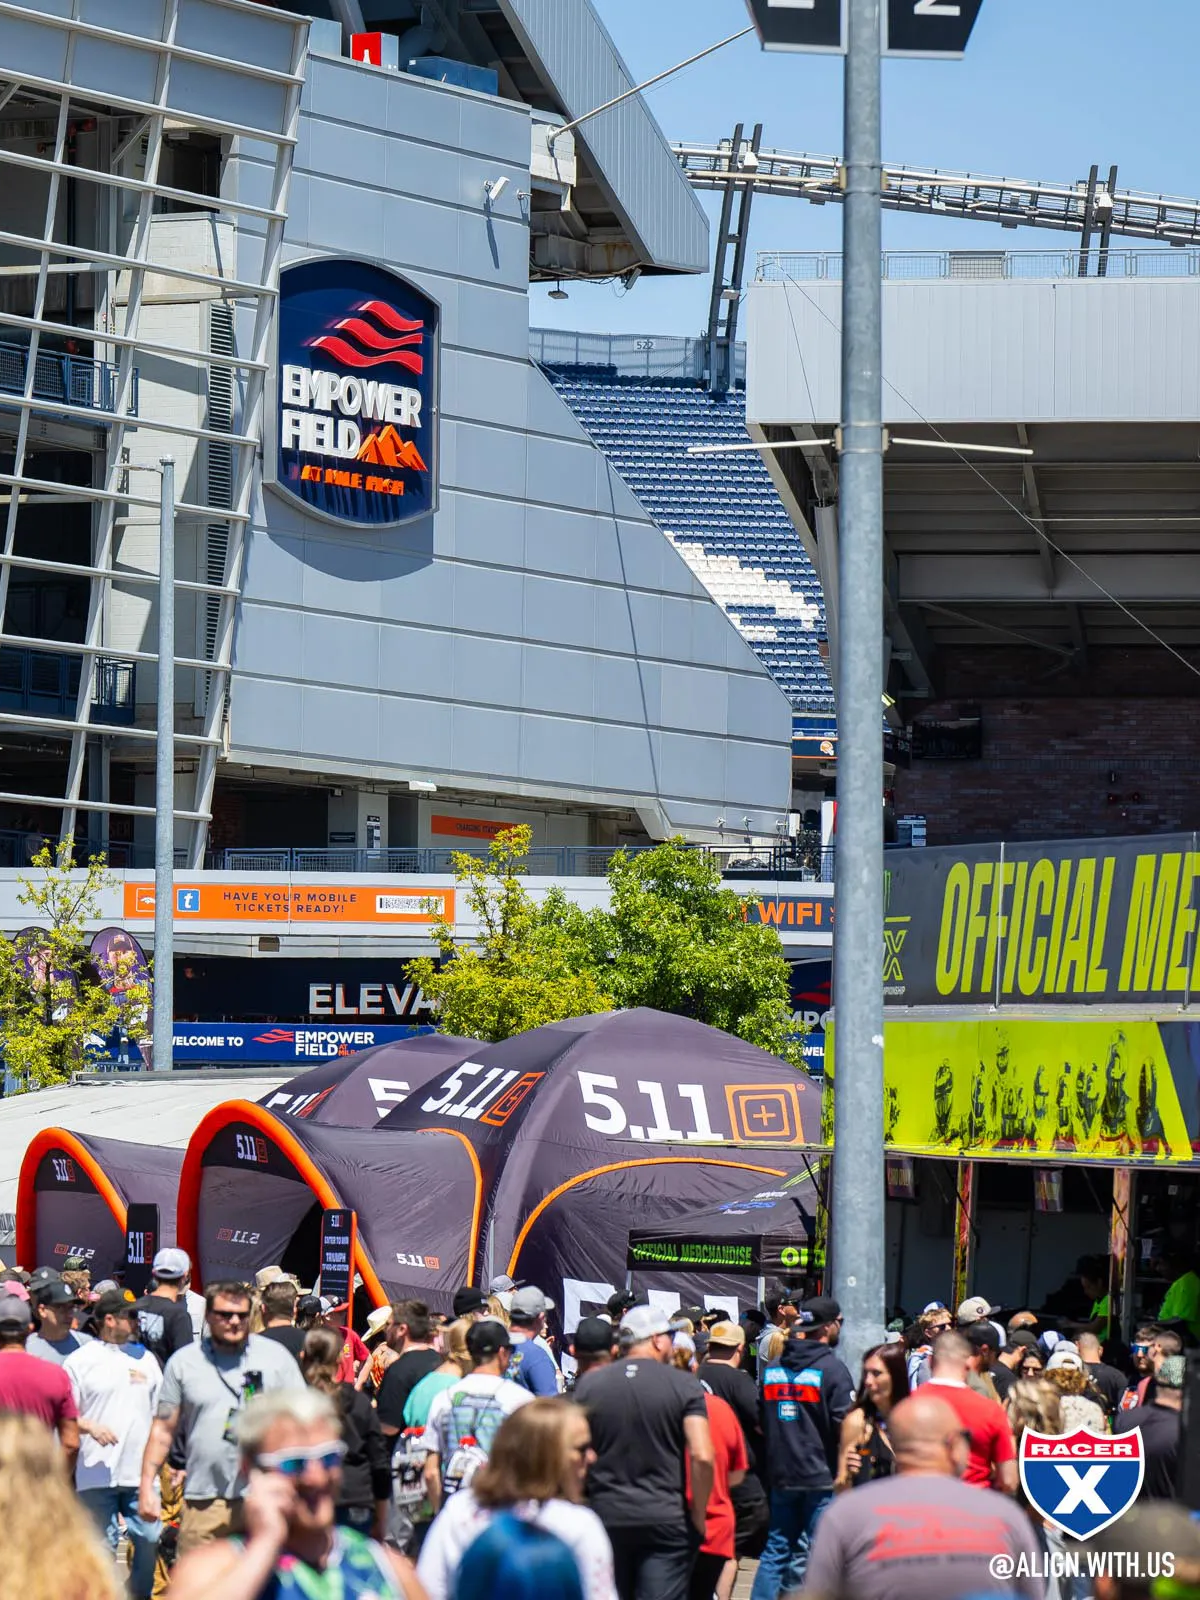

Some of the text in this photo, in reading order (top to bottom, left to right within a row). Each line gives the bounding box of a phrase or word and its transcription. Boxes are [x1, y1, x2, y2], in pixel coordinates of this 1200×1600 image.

[282, 364, 422, 428] EMPOWER
[281, 408, 361, 460] FIELD
[301, 464, 323, 482] AT
[324, 469, 363, 489] MILE
[223, 892, 357, 903] HAVE YOUR MOBILE
[235, 903, 345, 913] TICKETS READY!
[757, 901, 822, 926] WIFI
[935, 857, 1116, 996] OFFICIAL
[227, 1036, 244, 1047] TO
[295, 1031, 375, 1045] EMPOWER
[295, 1044, 339, 1057] FIELD
[420, 1061, 520, 1120] 5.11
[576, 1070, 725, 1141] 5.11
[236, 1134, 258, 1162] 5.11
[52, 1158, 68, 1183] 5.11
[127, 1231, 145, 1265] 5.11
[396, 1252, 425, 1269] 5.11
[632, 1242, 753, 1266] OFFICIAL MERCHANDISE
